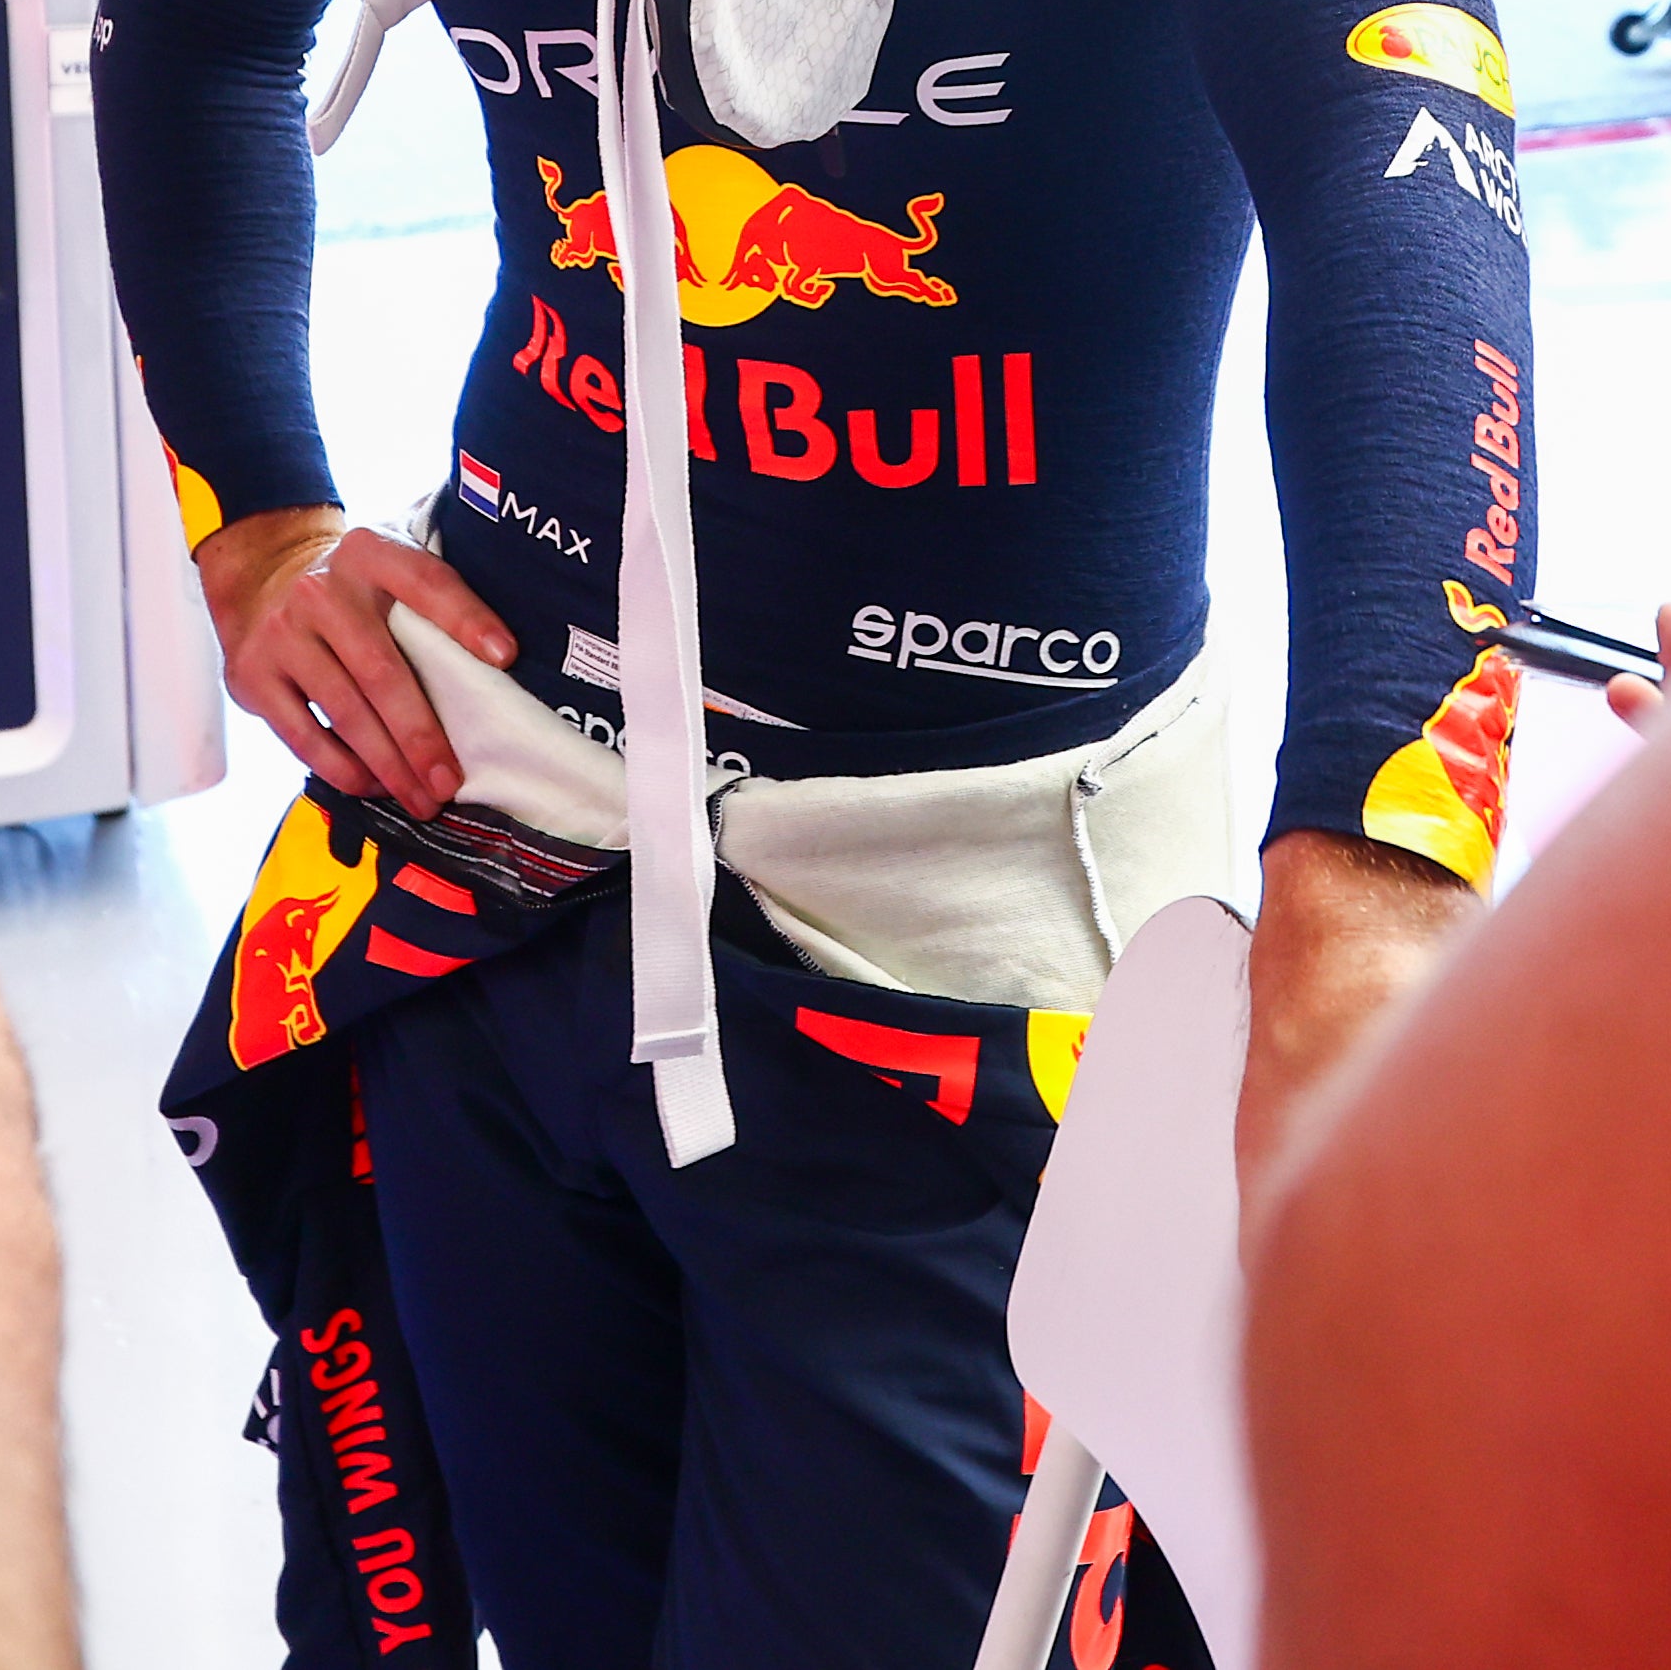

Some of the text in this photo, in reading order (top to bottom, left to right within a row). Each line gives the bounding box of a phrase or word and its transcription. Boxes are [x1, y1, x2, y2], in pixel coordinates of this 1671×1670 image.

[736, 352, 1037, 489] Bull
[1464, 338, 1521, 587] Red Bull
[501, 491, 592, 563] MAX
[850, 605, 1121, 682] sparco
[300, 1306, 433, 1654] YOU WINGS
